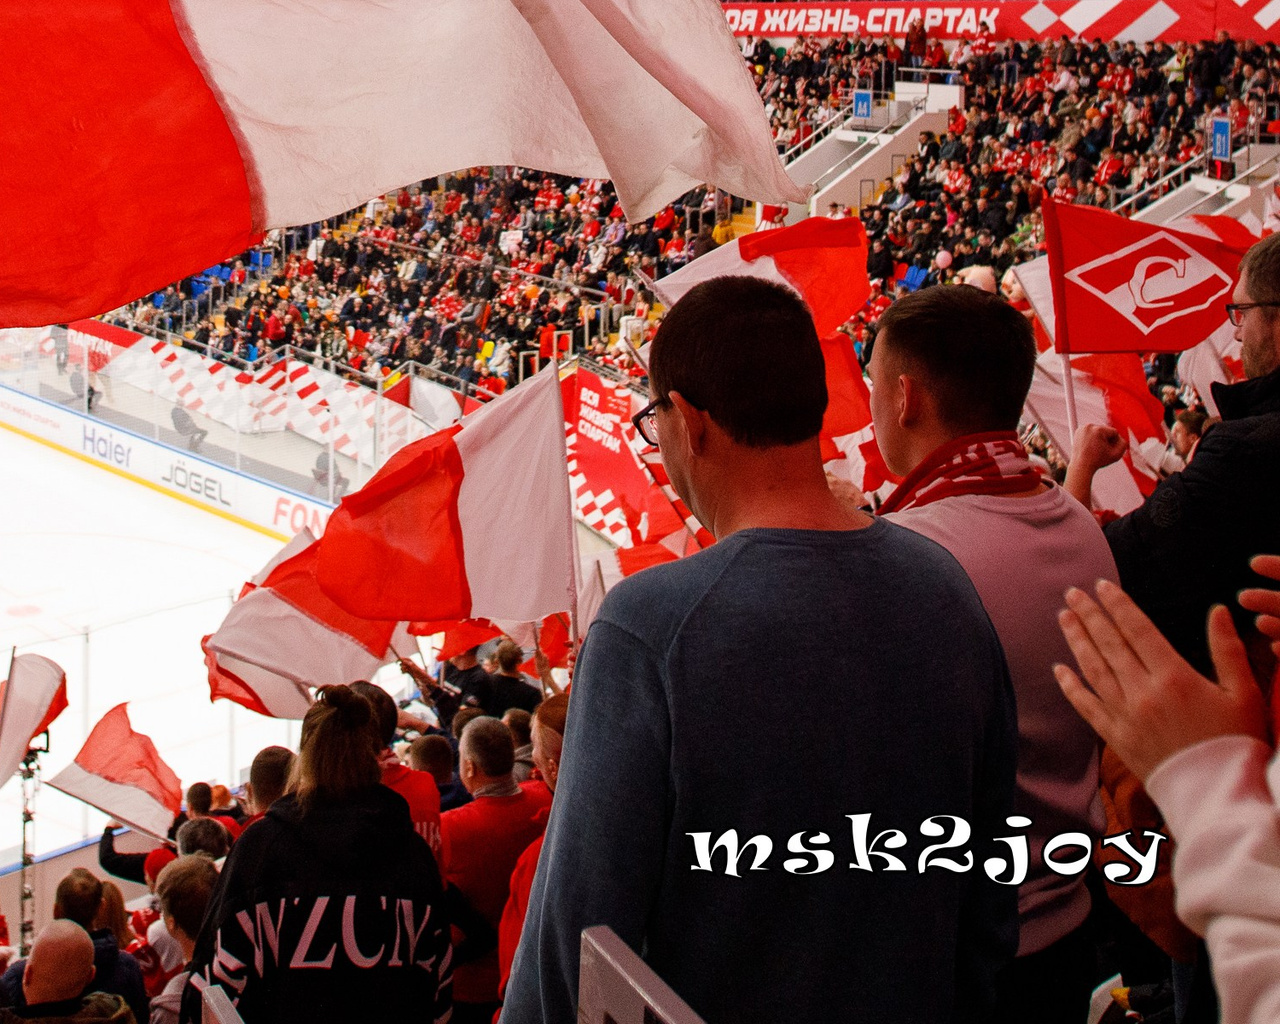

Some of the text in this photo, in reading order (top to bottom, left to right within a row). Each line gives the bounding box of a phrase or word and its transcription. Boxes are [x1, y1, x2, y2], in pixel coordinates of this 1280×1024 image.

[725, 9, 758, 31] ОЯ
[580, 387, 600, 408] ВСЯ
[82, 424, 132, 467] Haier
[577, 419, 621, 454] СПАРТАК
[161, 460, 232, 507] JÖGEL
